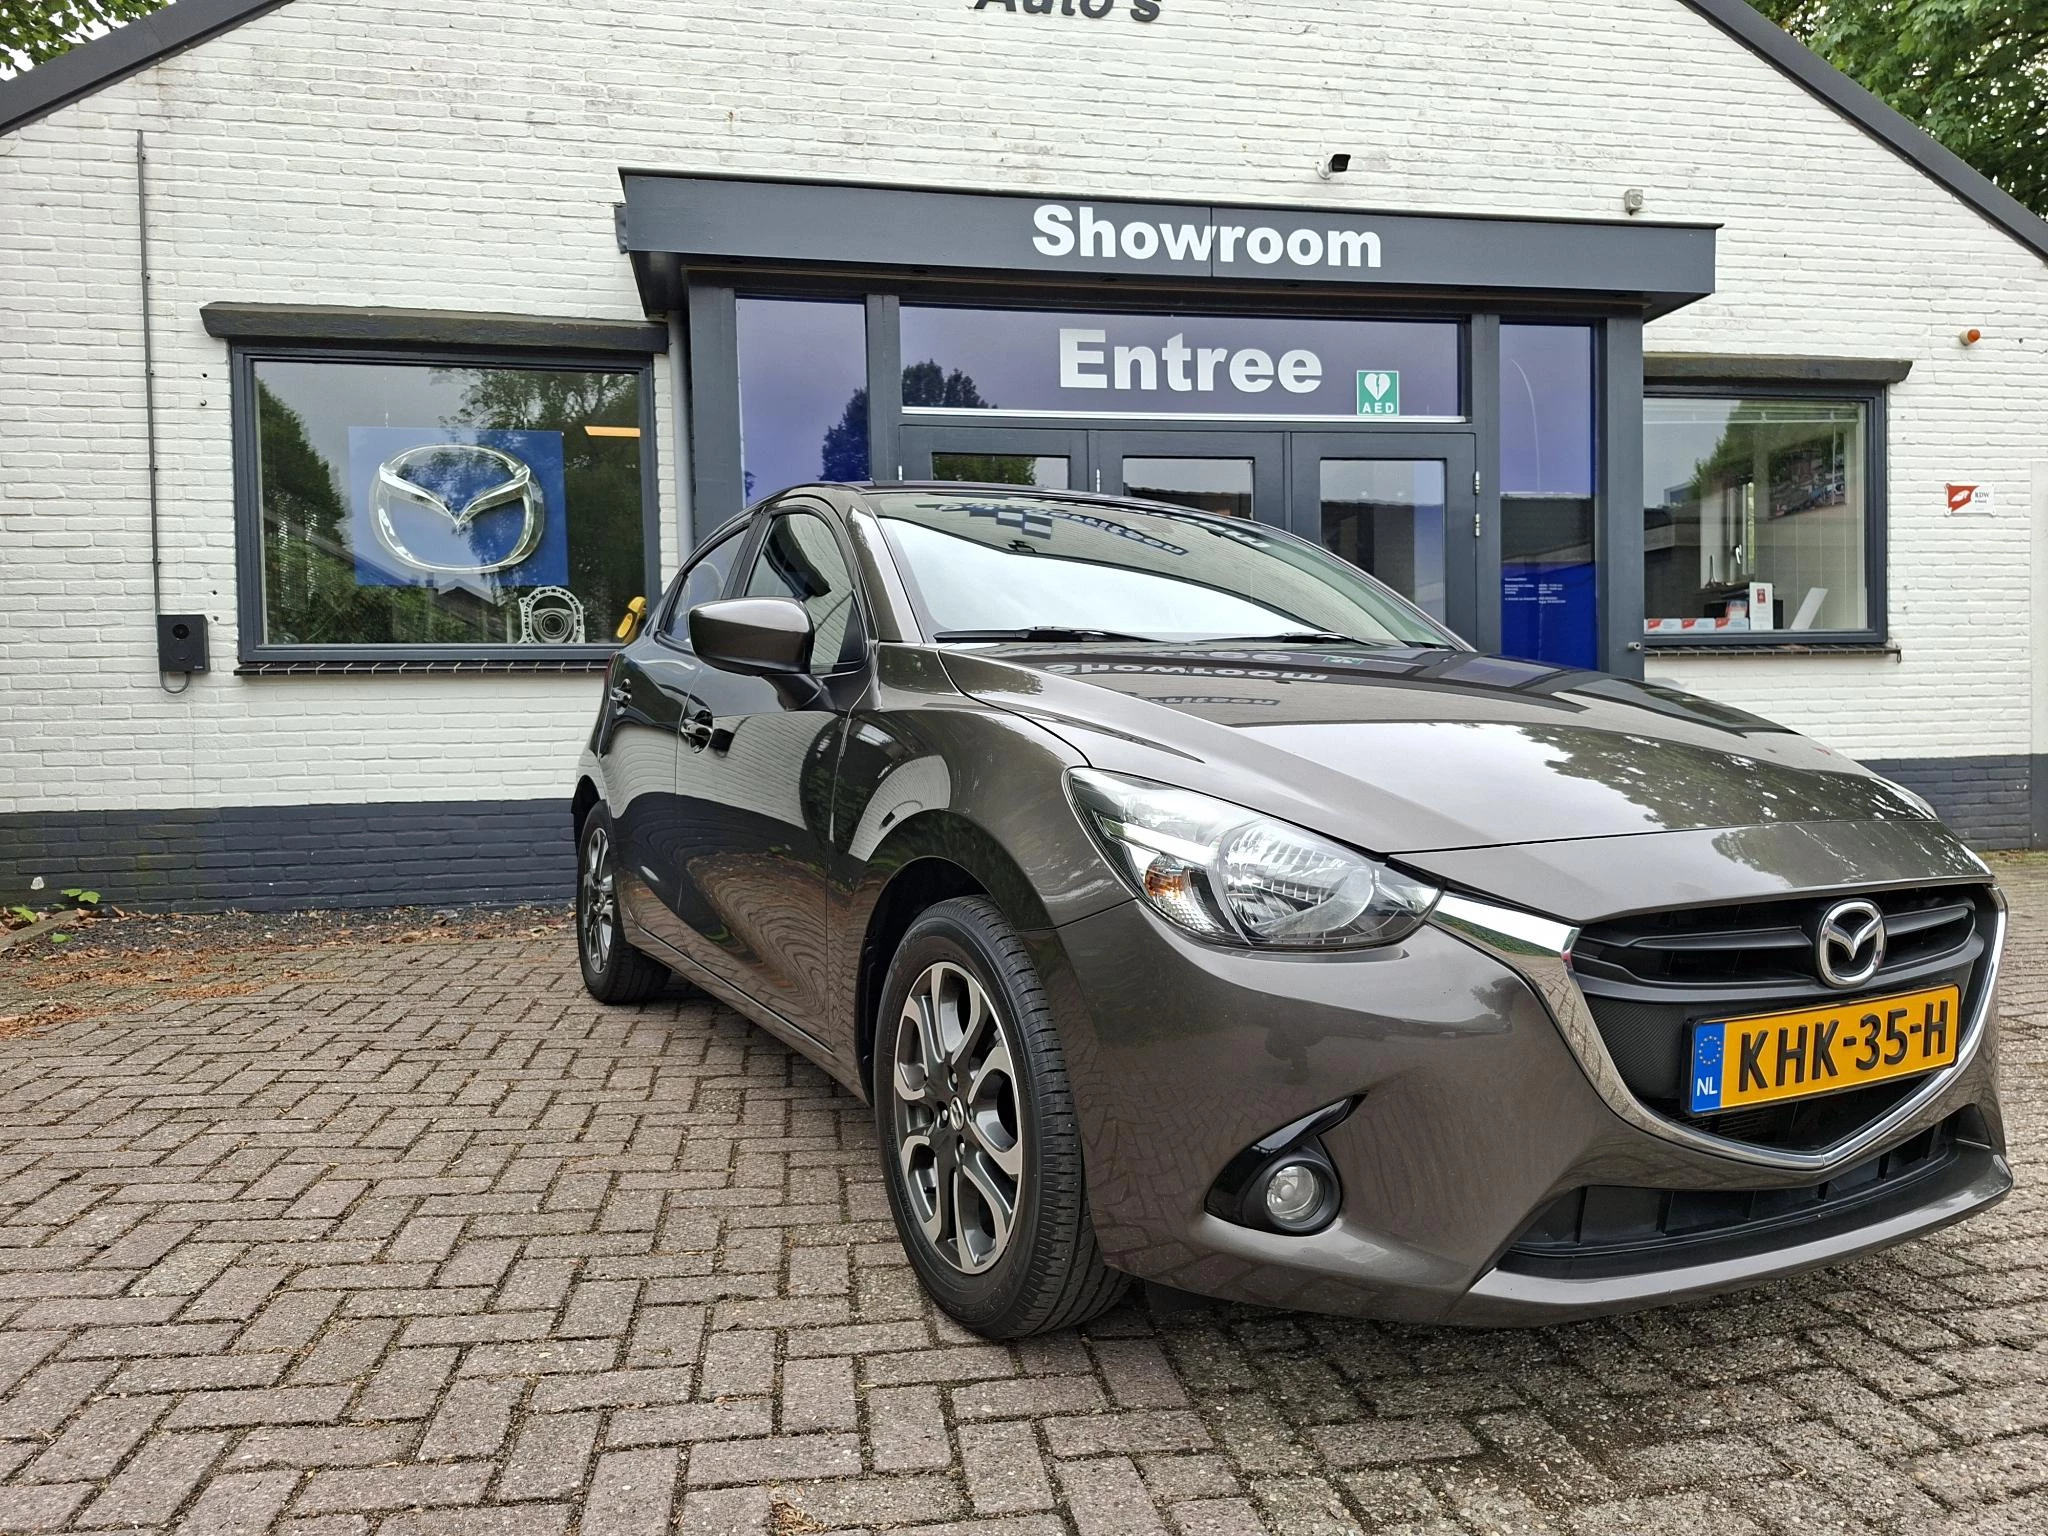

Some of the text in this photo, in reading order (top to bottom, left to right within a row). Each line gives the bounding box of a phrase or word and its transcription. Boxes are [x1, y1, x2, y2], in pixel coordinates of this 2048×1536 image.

[1032, 204, 1381, 268] Showroom
[1059, 328, 1322, 393] Entree
[1362, 402, 1394, 414] AED
[1738, 999, 1949, 1093] KHK-35-H
[1696, 1077, 1718, 1097] NL
